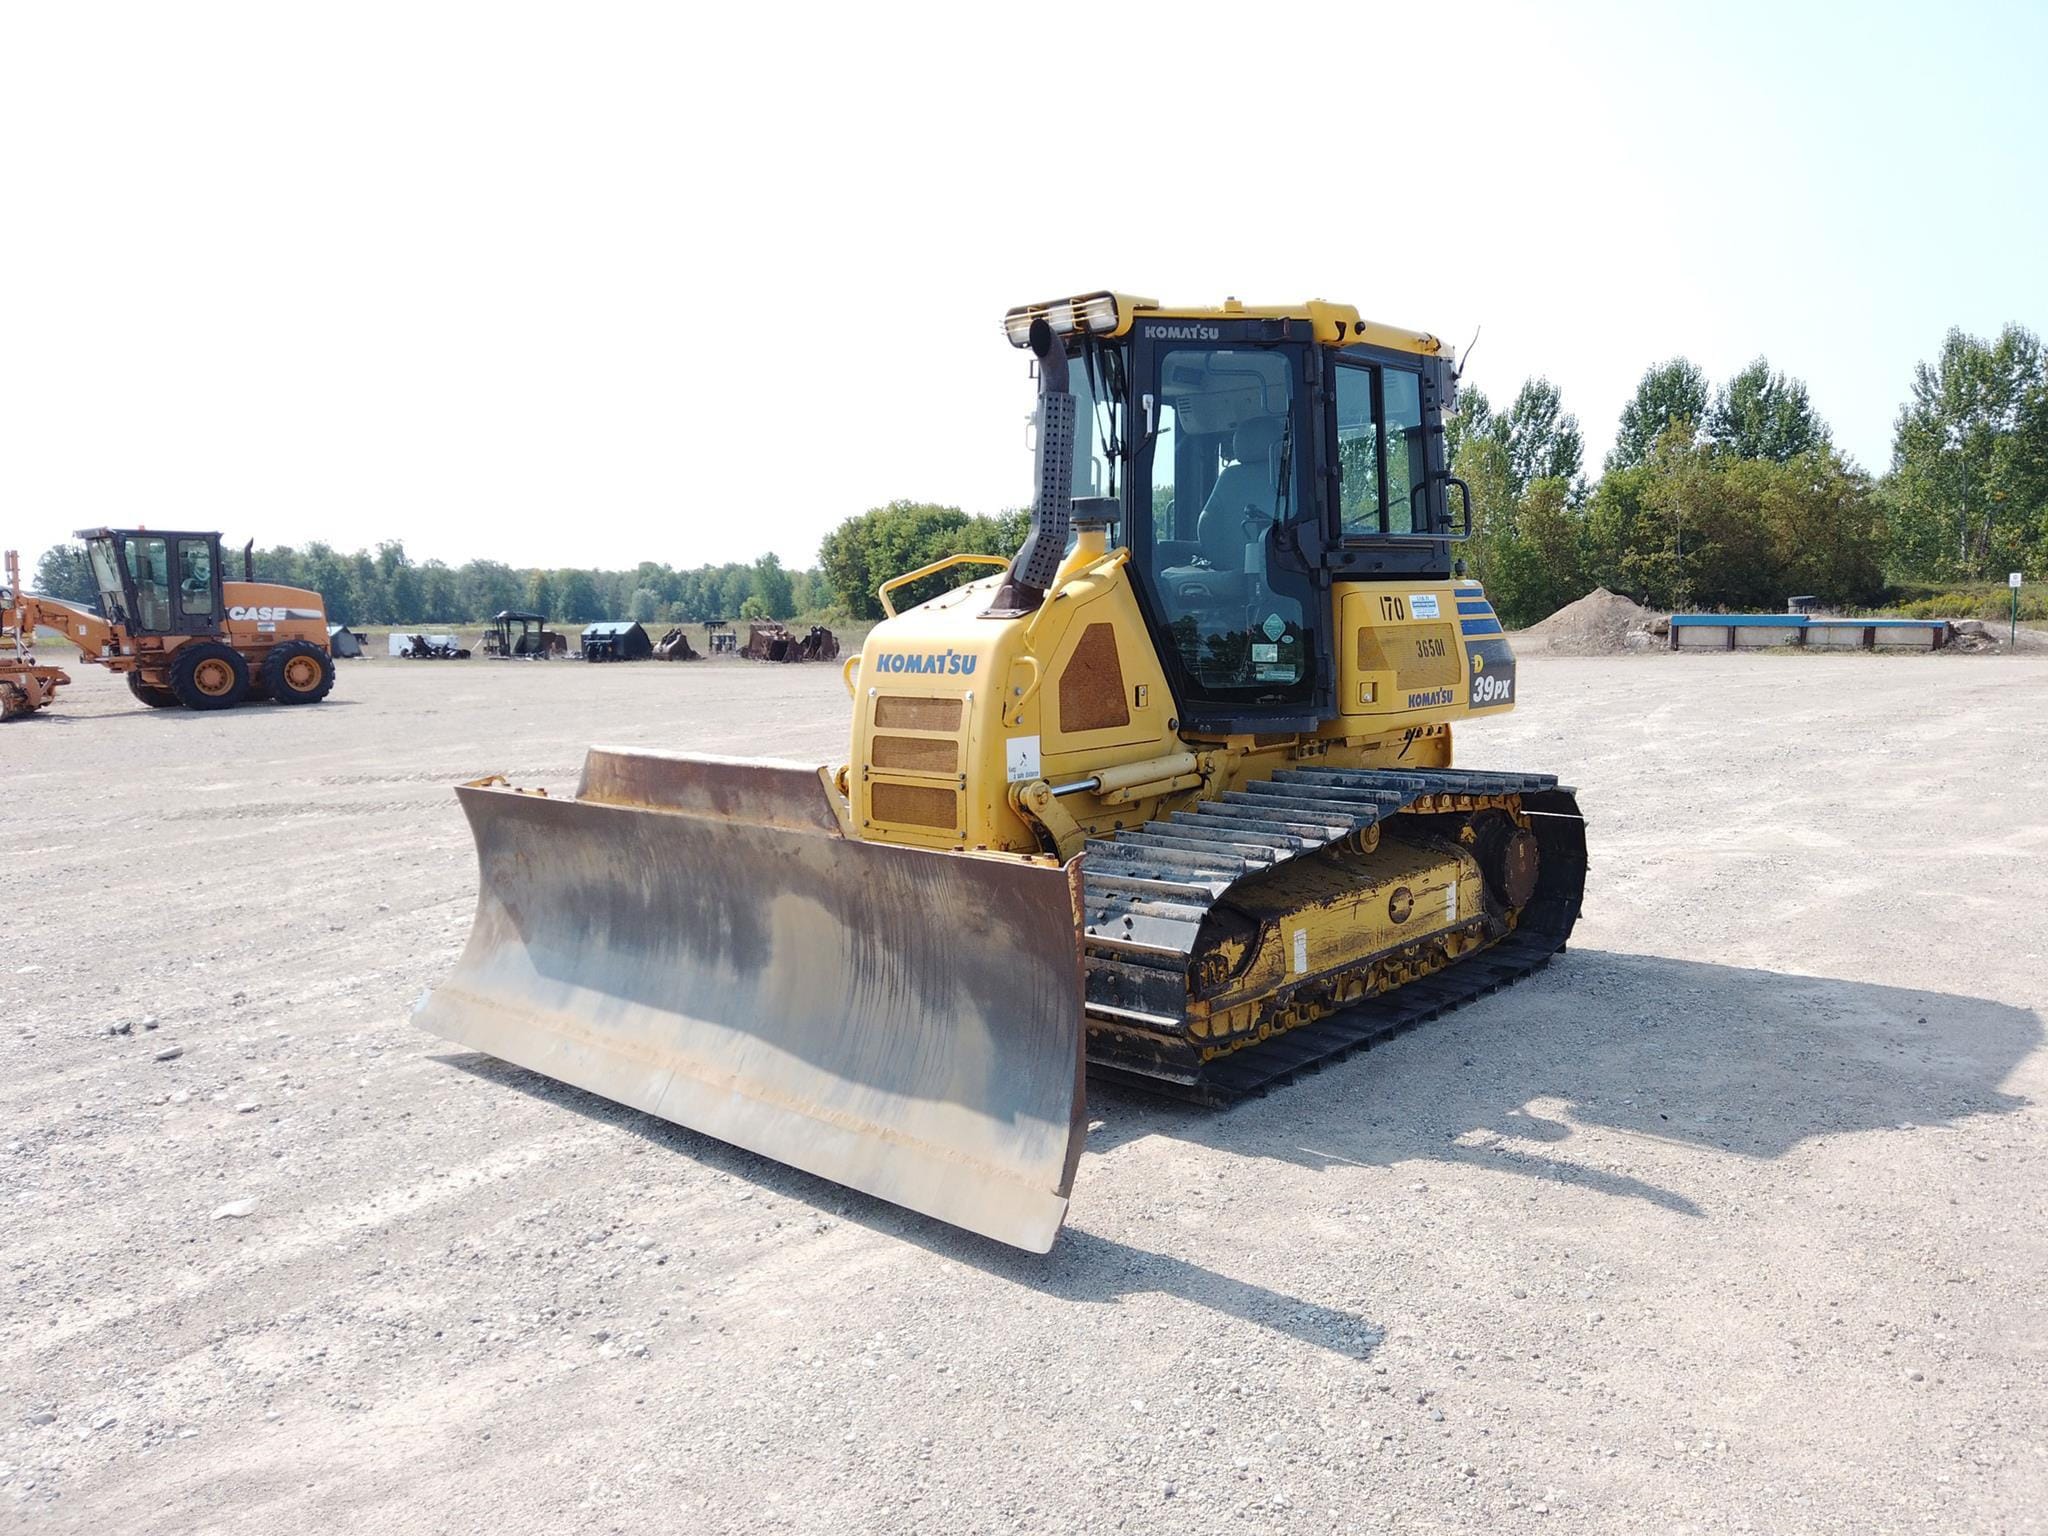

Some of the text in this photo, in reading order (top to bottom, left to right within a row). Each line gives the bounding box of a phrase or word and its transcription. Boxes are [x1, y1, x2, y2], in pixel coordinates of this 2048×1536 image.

[1144, 323, 1220, 340] KOMATSU
[229, 606, 287, 621] CASE
[876, 648, 978, 675] KOMATSU
[1473, 654, 1484, 674] D
[1408, 687, 1454, 708] KOMATSU
[1472, 675, 1512, 703] 39PX
